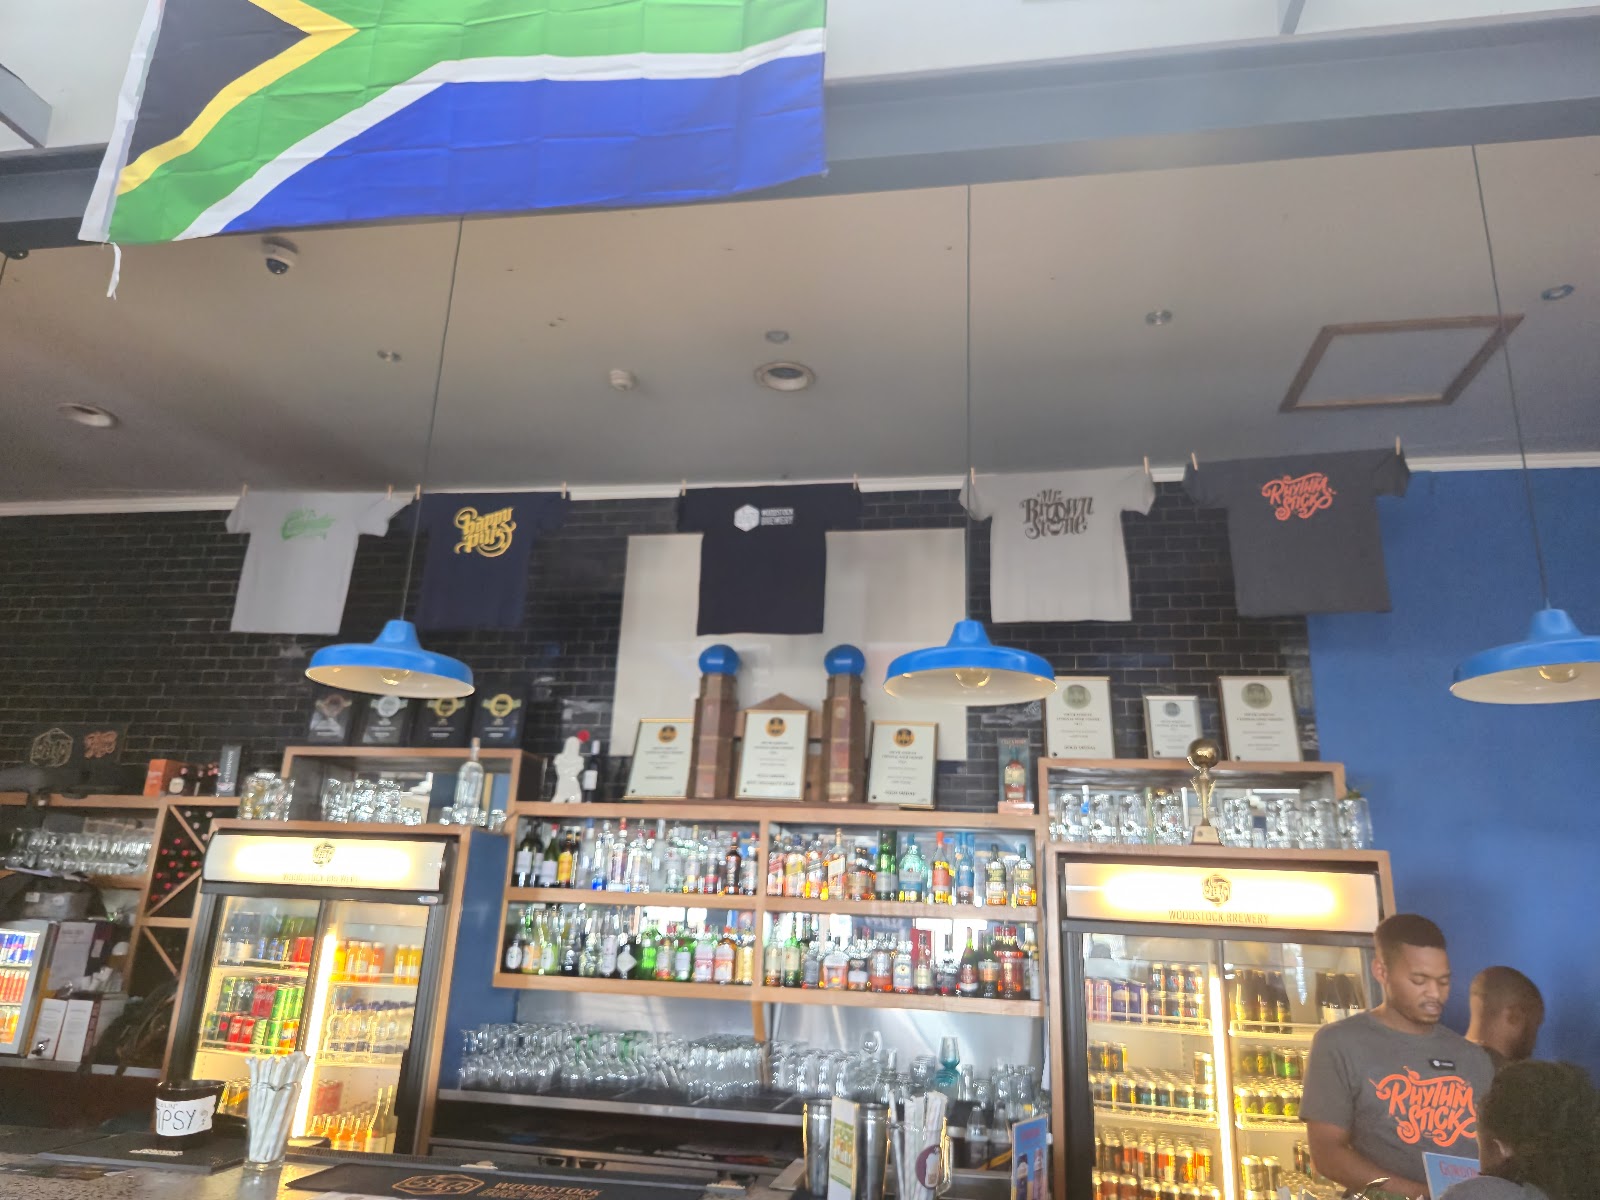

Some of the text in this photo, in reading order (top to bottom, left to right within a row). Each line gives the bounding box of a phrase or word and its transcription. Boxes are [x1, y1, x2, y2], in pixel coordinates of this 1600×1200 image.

[1168, 910, 1270, 924] WOODSTOCK BREWERY
[1376, 1072, 1476, 1118] RHYTHM
